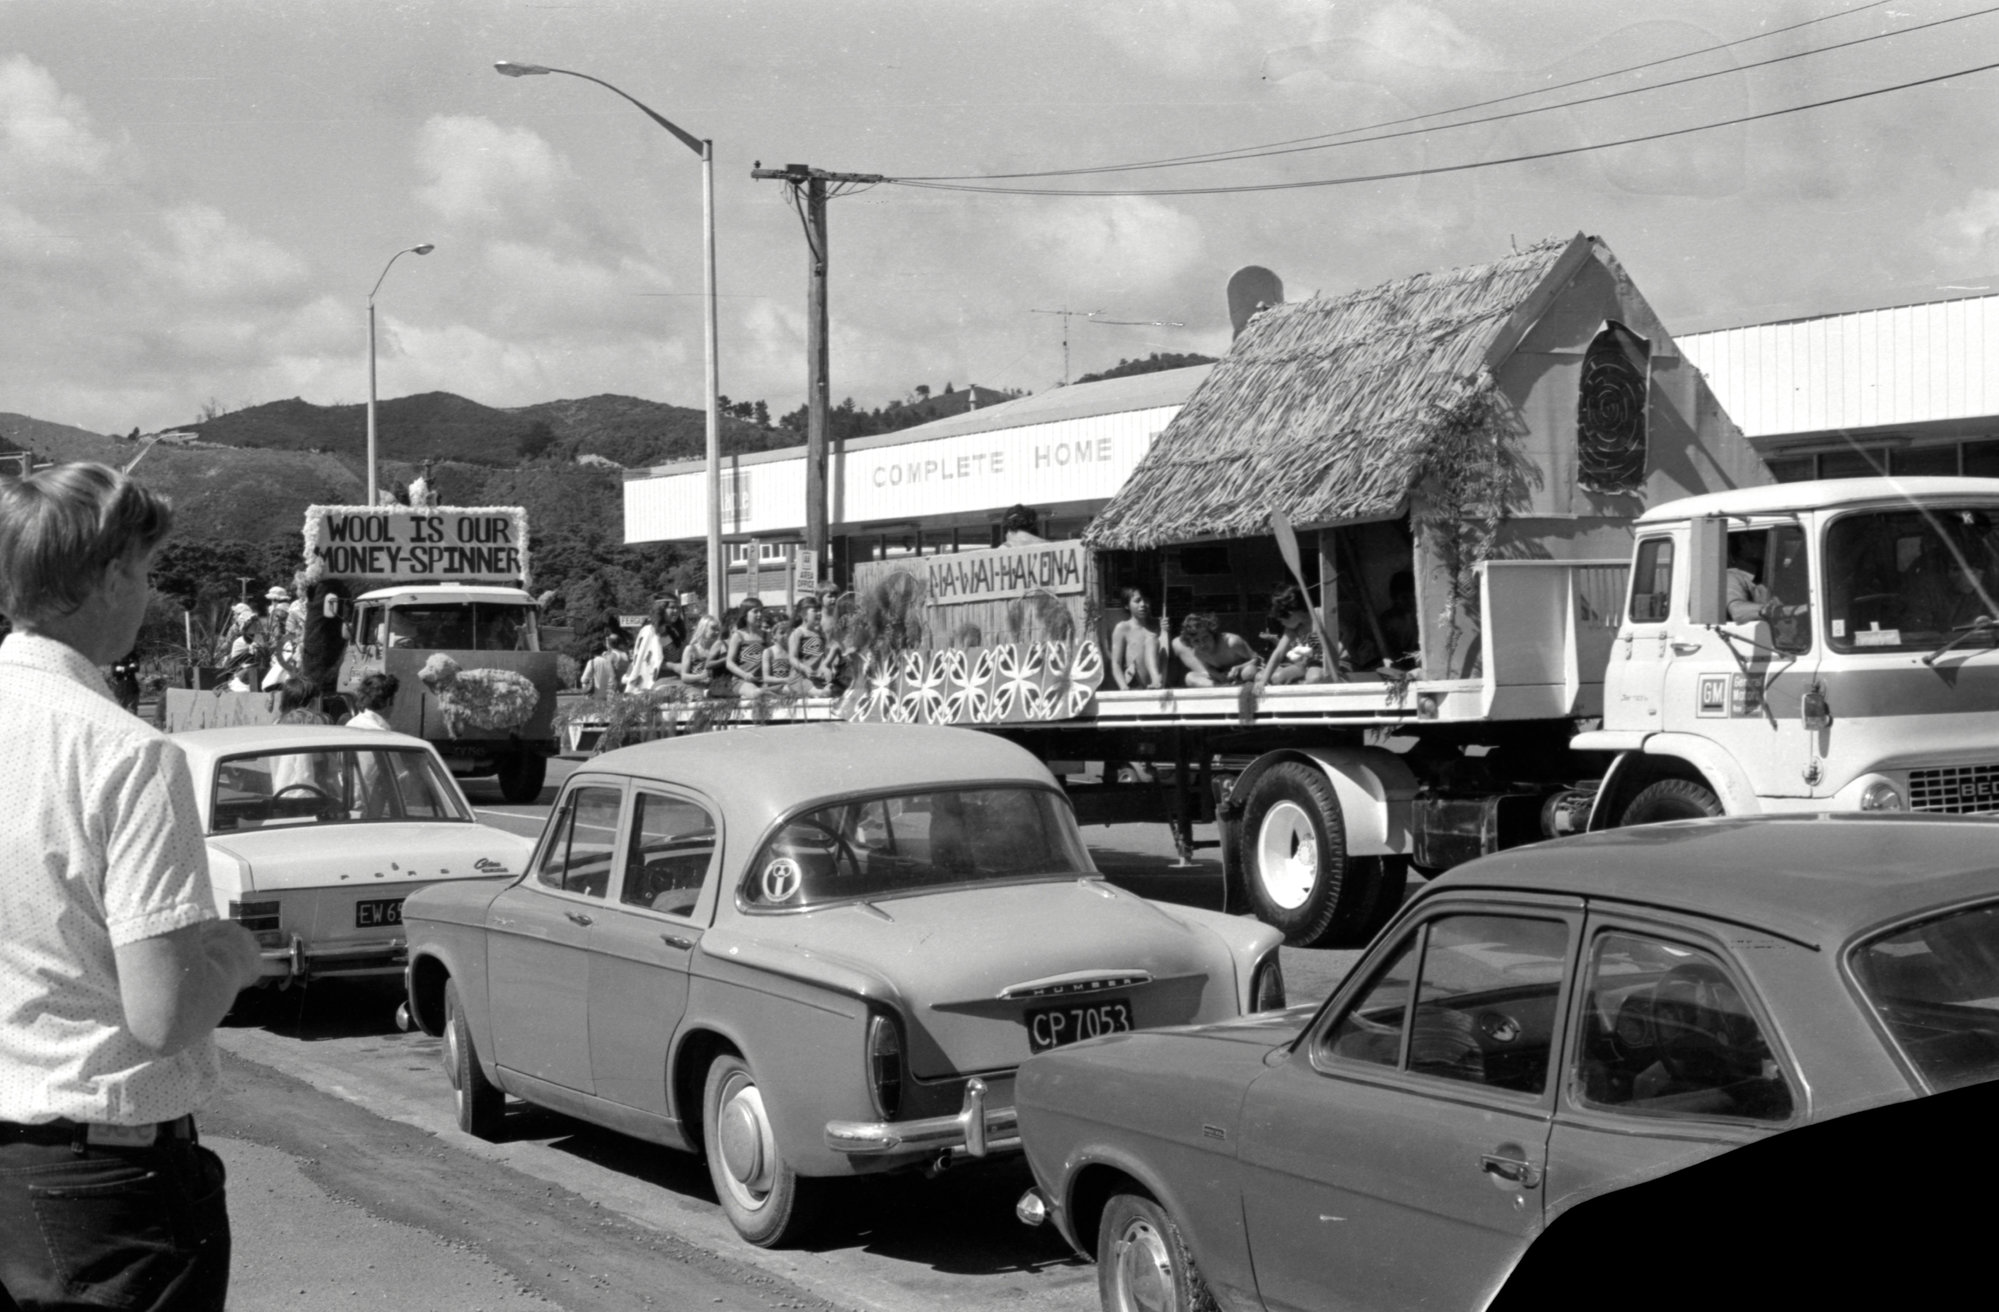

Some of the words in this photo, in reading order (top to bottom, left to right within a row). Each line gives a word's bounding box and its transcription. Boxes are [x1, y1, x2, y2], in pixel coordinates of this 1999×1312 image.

[872, 450, 1005, 488] COMPLETE
[1033, 437, 1112, 469] HOME
[327, 515, 395, 543] WOOL
[409, 516, 444, 543] IS
[457, 516, 511, 544] OUR
[314, 546, 522, 575] MONEY-SPINNER
[1703, 681, 1724, 704] GM
[359, 902, 383, 925] EW
[1033, 977, 1132, 996] HUMBER
[1033, 1011, 1066, 1047] CP
[1070, 1004, 1130, 1042] 7053
